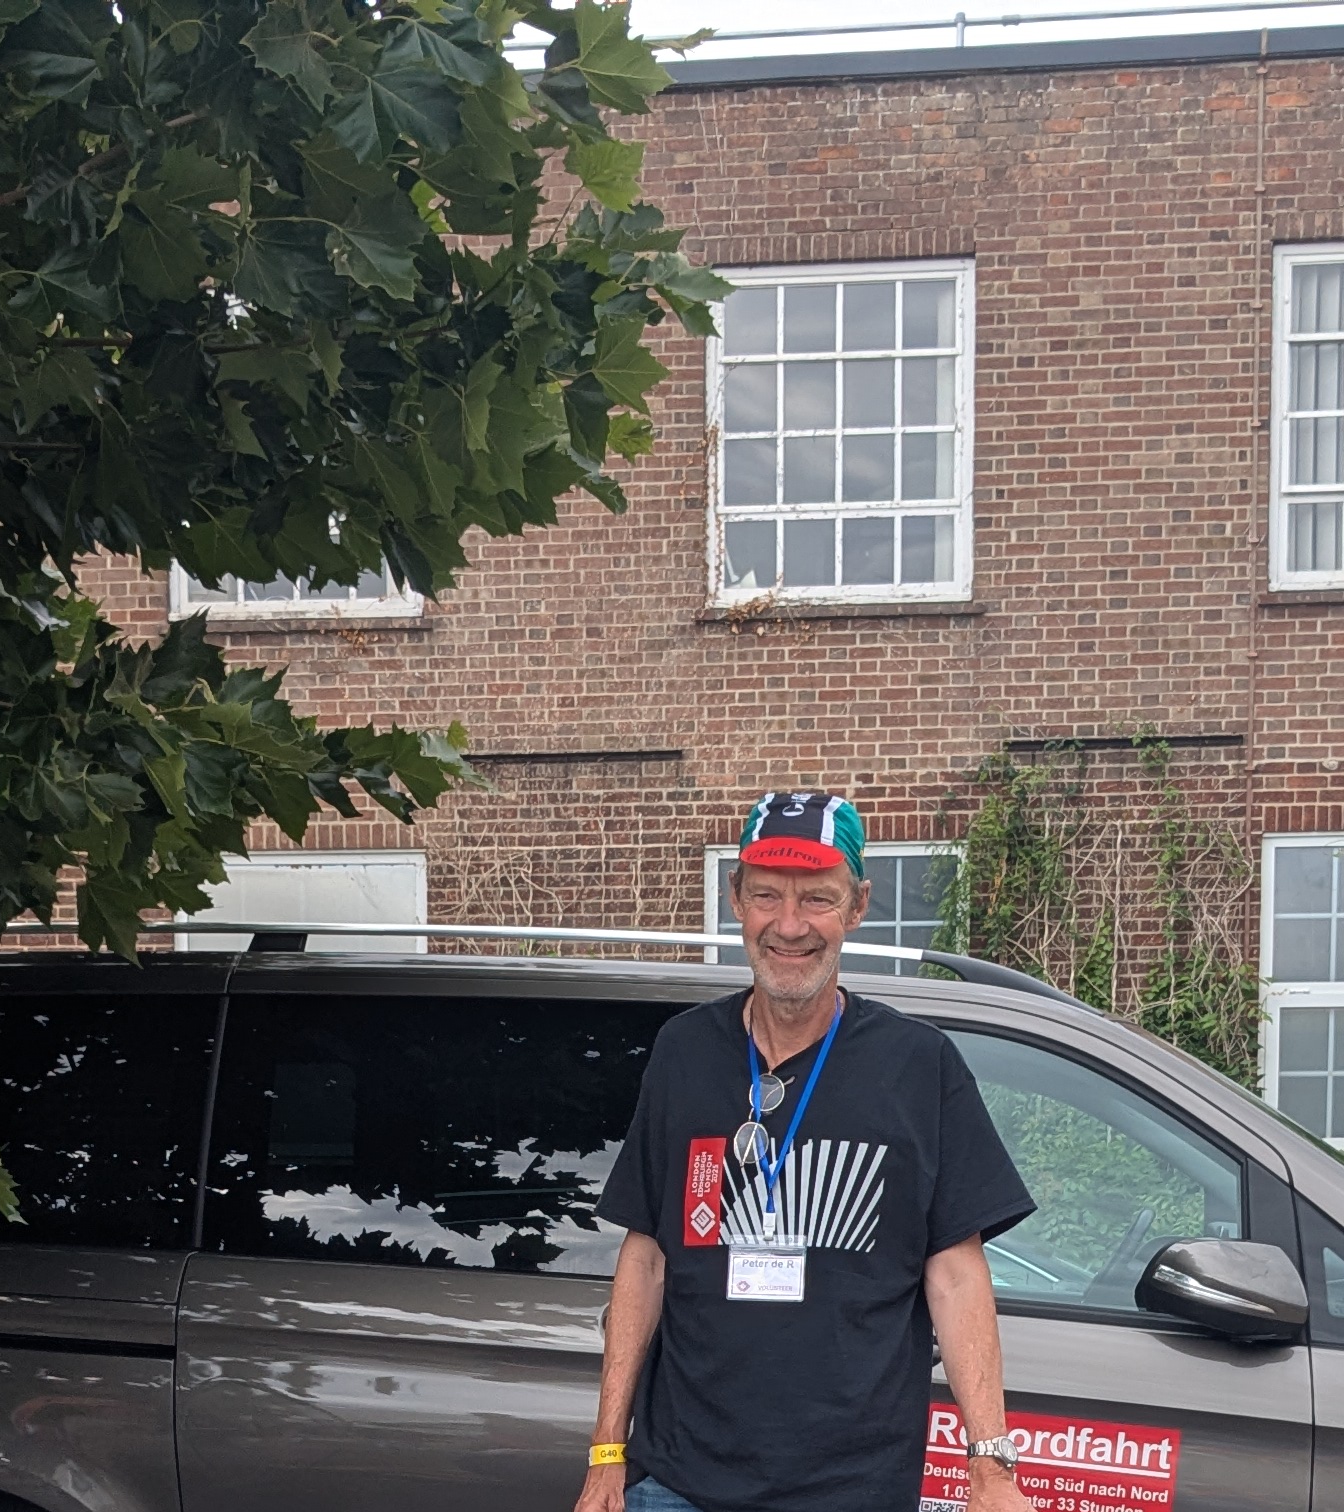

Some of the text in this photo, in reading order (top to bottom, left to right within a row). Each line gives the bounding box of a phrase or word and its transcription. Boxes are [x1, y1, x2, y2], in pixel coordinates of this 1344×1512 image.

[692, 1155, 700, 1193] LONDON
[704, 1155, 713, 1193] LONDON
[711, 1164, 719, 1183] 2025
[742, 1259, 768, 1268] Peter
[771, 1260, 783, 1268] de
[929, 1411, 1173, 1470] Rordfahrt
[1021, 1475, 1169, 1503] von Süd nach Nord
[1057, 1497, 1075, 1512] 33
